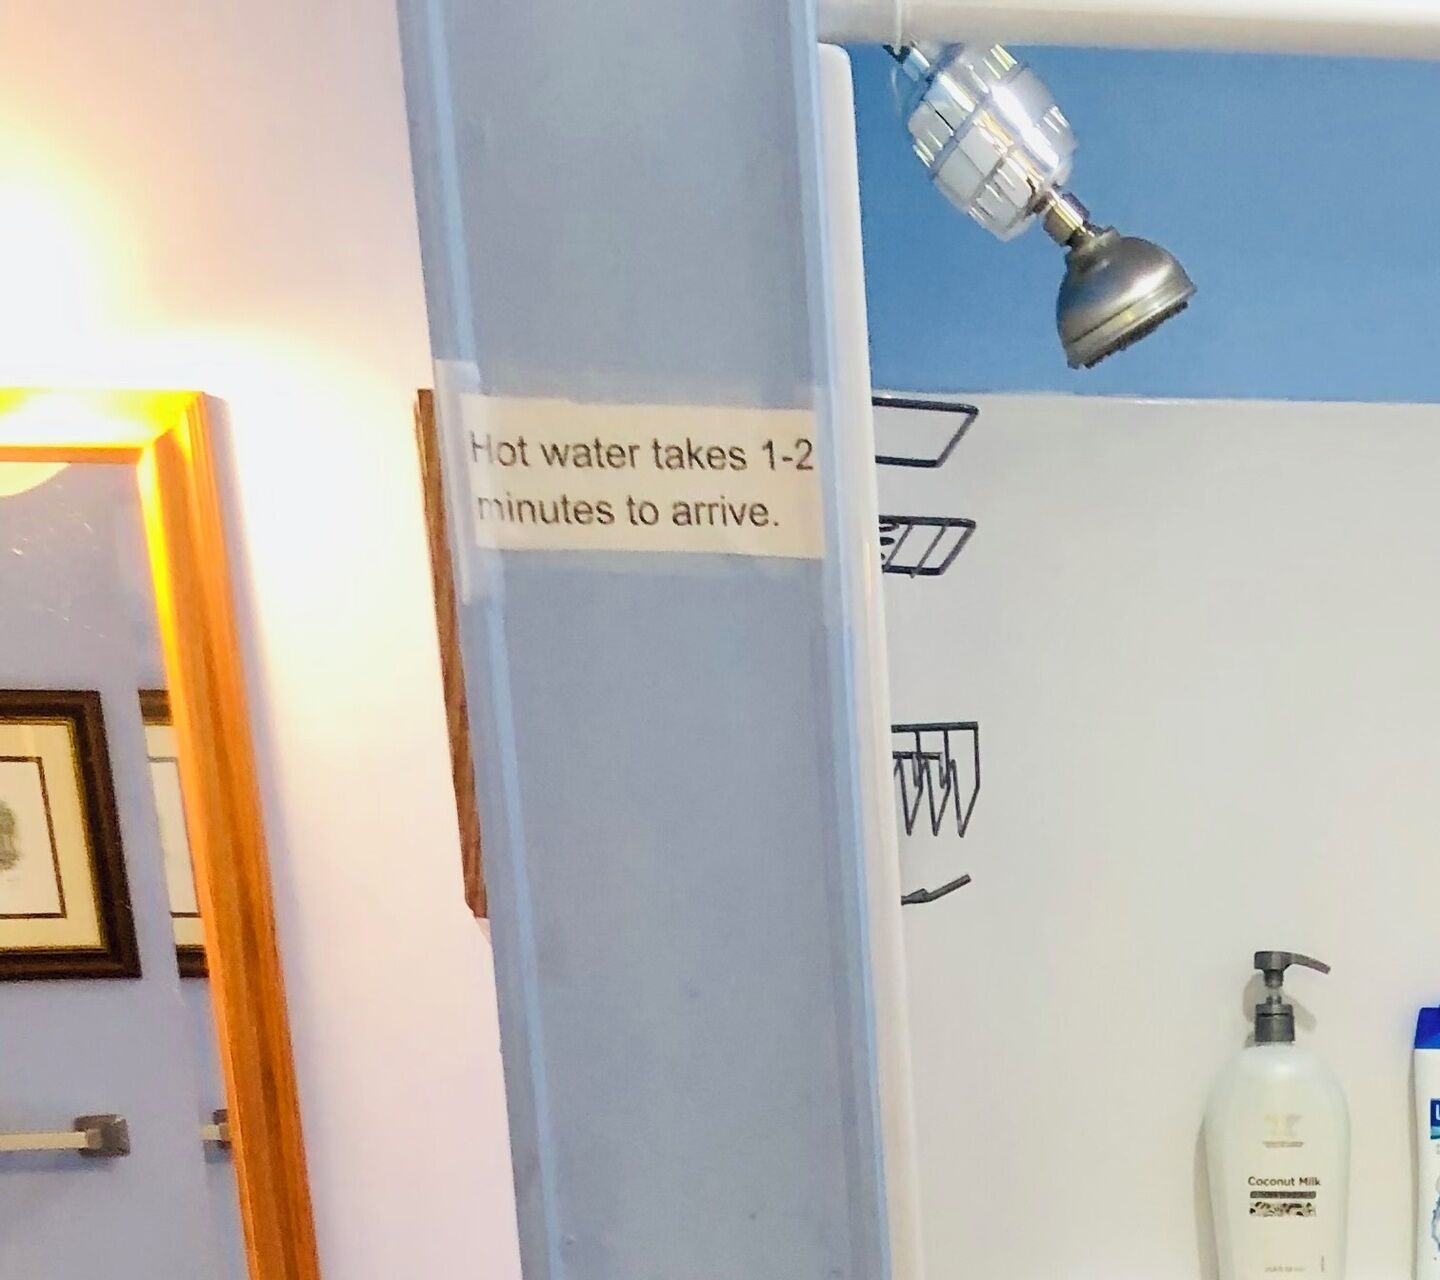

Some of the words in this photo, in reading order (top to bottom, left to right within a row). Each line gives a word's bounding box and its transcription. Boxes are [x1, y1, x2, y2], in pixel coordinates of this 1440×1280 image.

[468, 431, 529, 468] Hot
[540, 437, 641, 470] water
[654, 438, 747, 471] takes
[762, 438, 815, 471] 1-2
[477, 491, 615, 526] minutes
[627, 496, 659, 526] to
[672, 495, 780, 528] arrive.
[1248, 1176, 1295, 1187] Coconut
[1298, 1176, 1321, 1186] Milk
